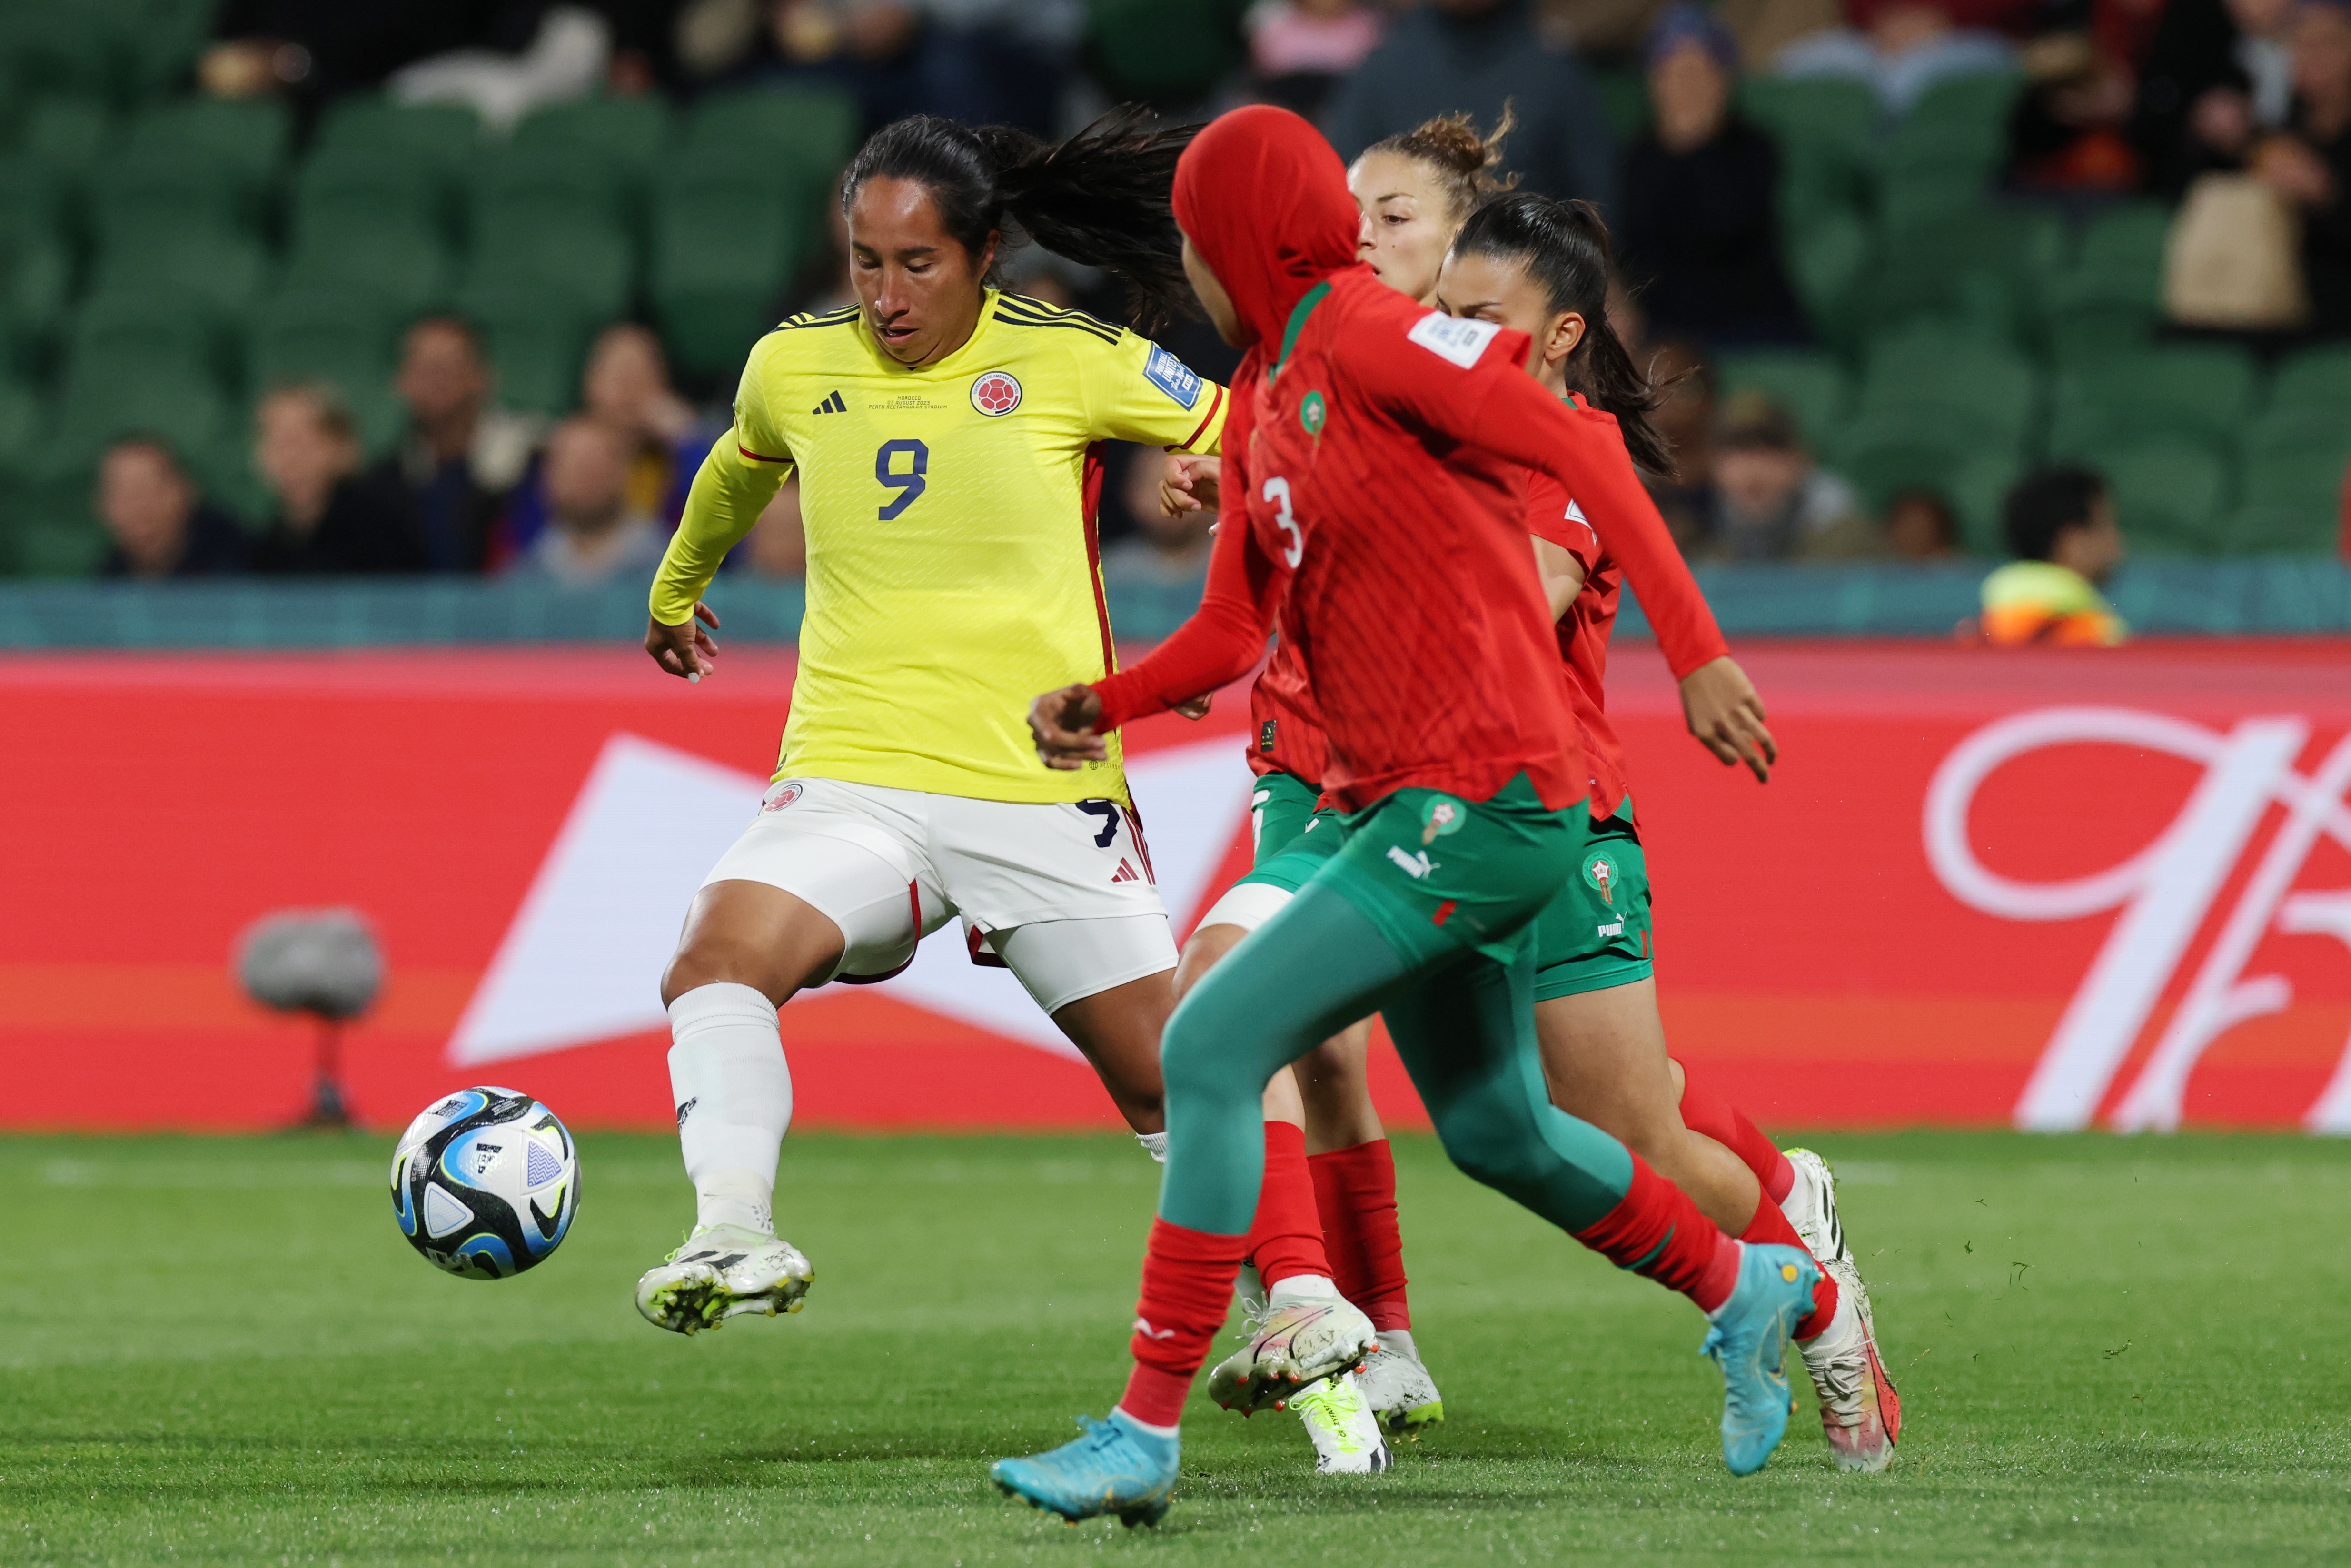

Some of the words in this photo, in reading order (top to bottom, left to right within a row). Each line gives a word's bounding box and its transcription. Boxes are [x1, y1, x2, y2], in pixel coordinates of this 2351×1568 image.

[1155, 352, 1168, 376] FOOTBALL
[1162, 357, 1177, 382] UNITES
[1171, 379, 1180, 391] the
[876, 439, 929, 520] 9
[1262, 476, 1303, 568] 3
